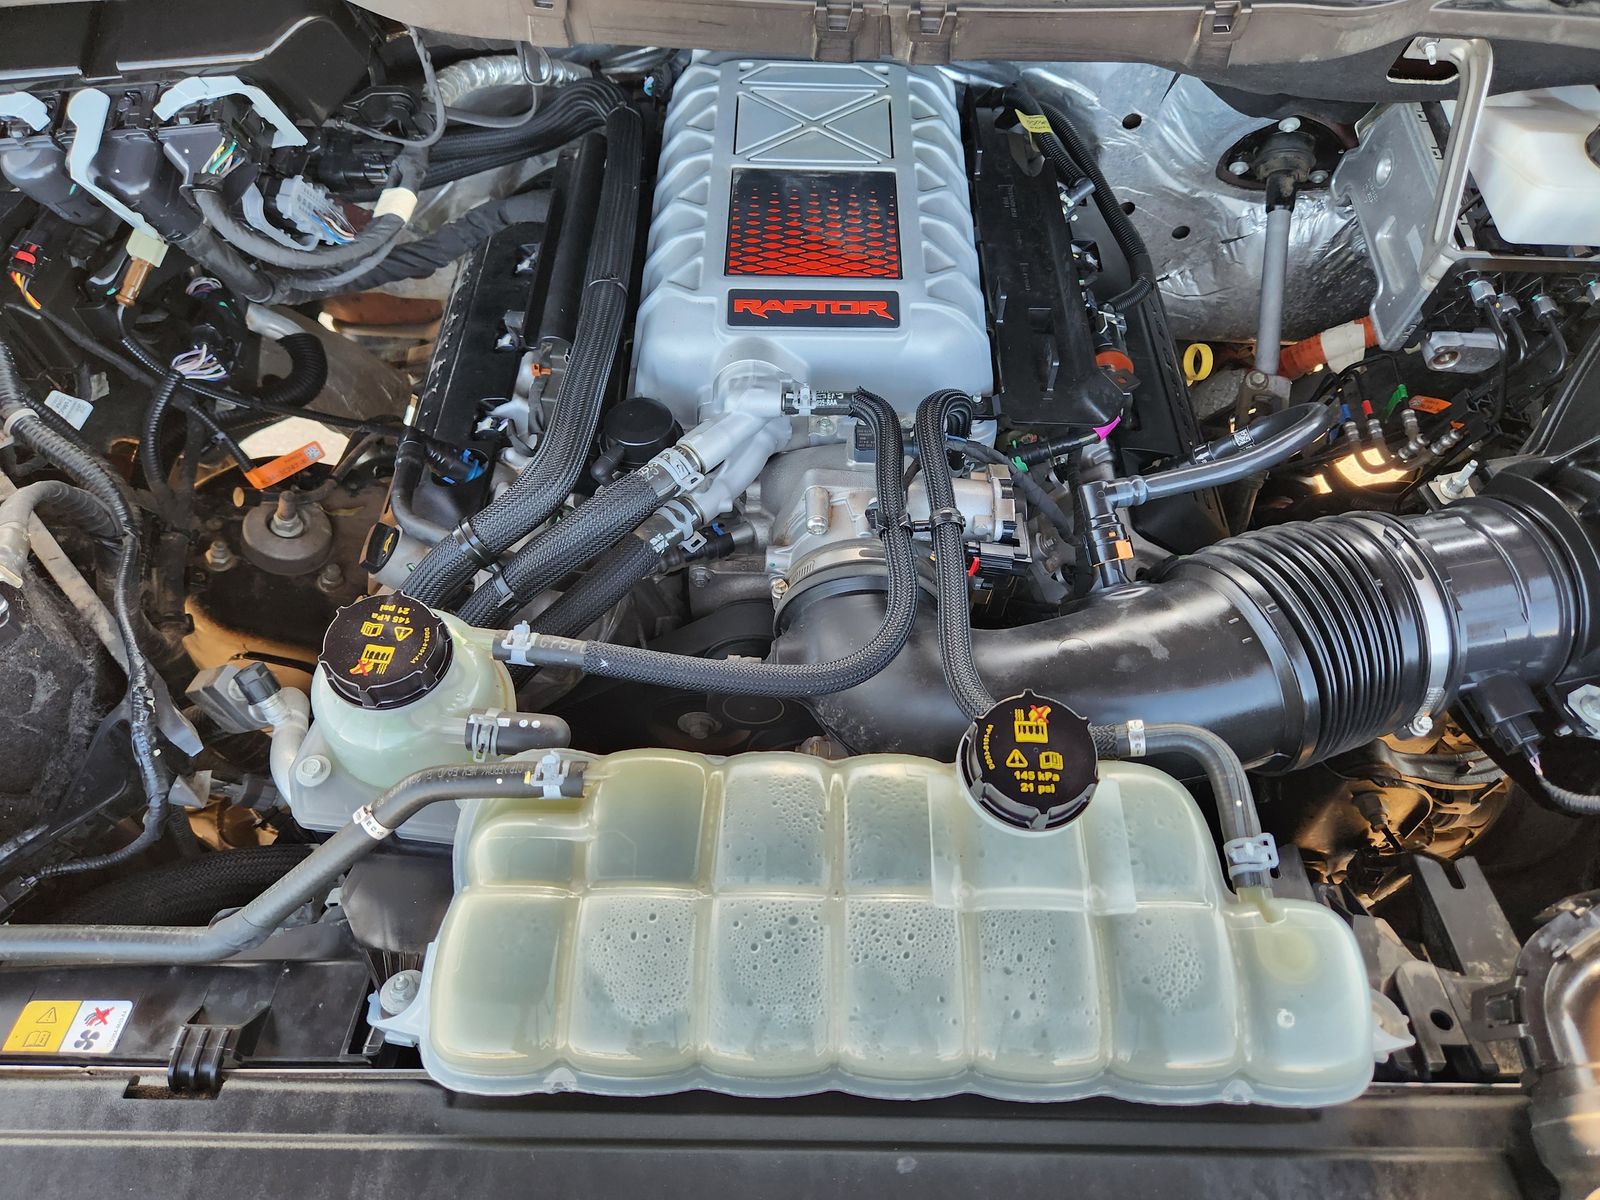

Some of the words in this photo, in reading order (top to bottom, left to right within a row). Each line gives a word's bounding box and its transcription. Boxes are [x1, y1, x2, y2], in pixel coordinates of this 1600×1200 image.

[734, 299, 895, 321] RAPTOR
[379, 604, 396, 613] psi
[397, 606, 411, 615] 21
[371, 612, 390, 622] kPa
[391, 616, 411, 625] 145
[1014, 770, 1036, 781] 145
[1037, 771, 1060, 782] kPa
[1020, 782, 1034, 793] 21
[1037, 783, 1056, 795] psi
